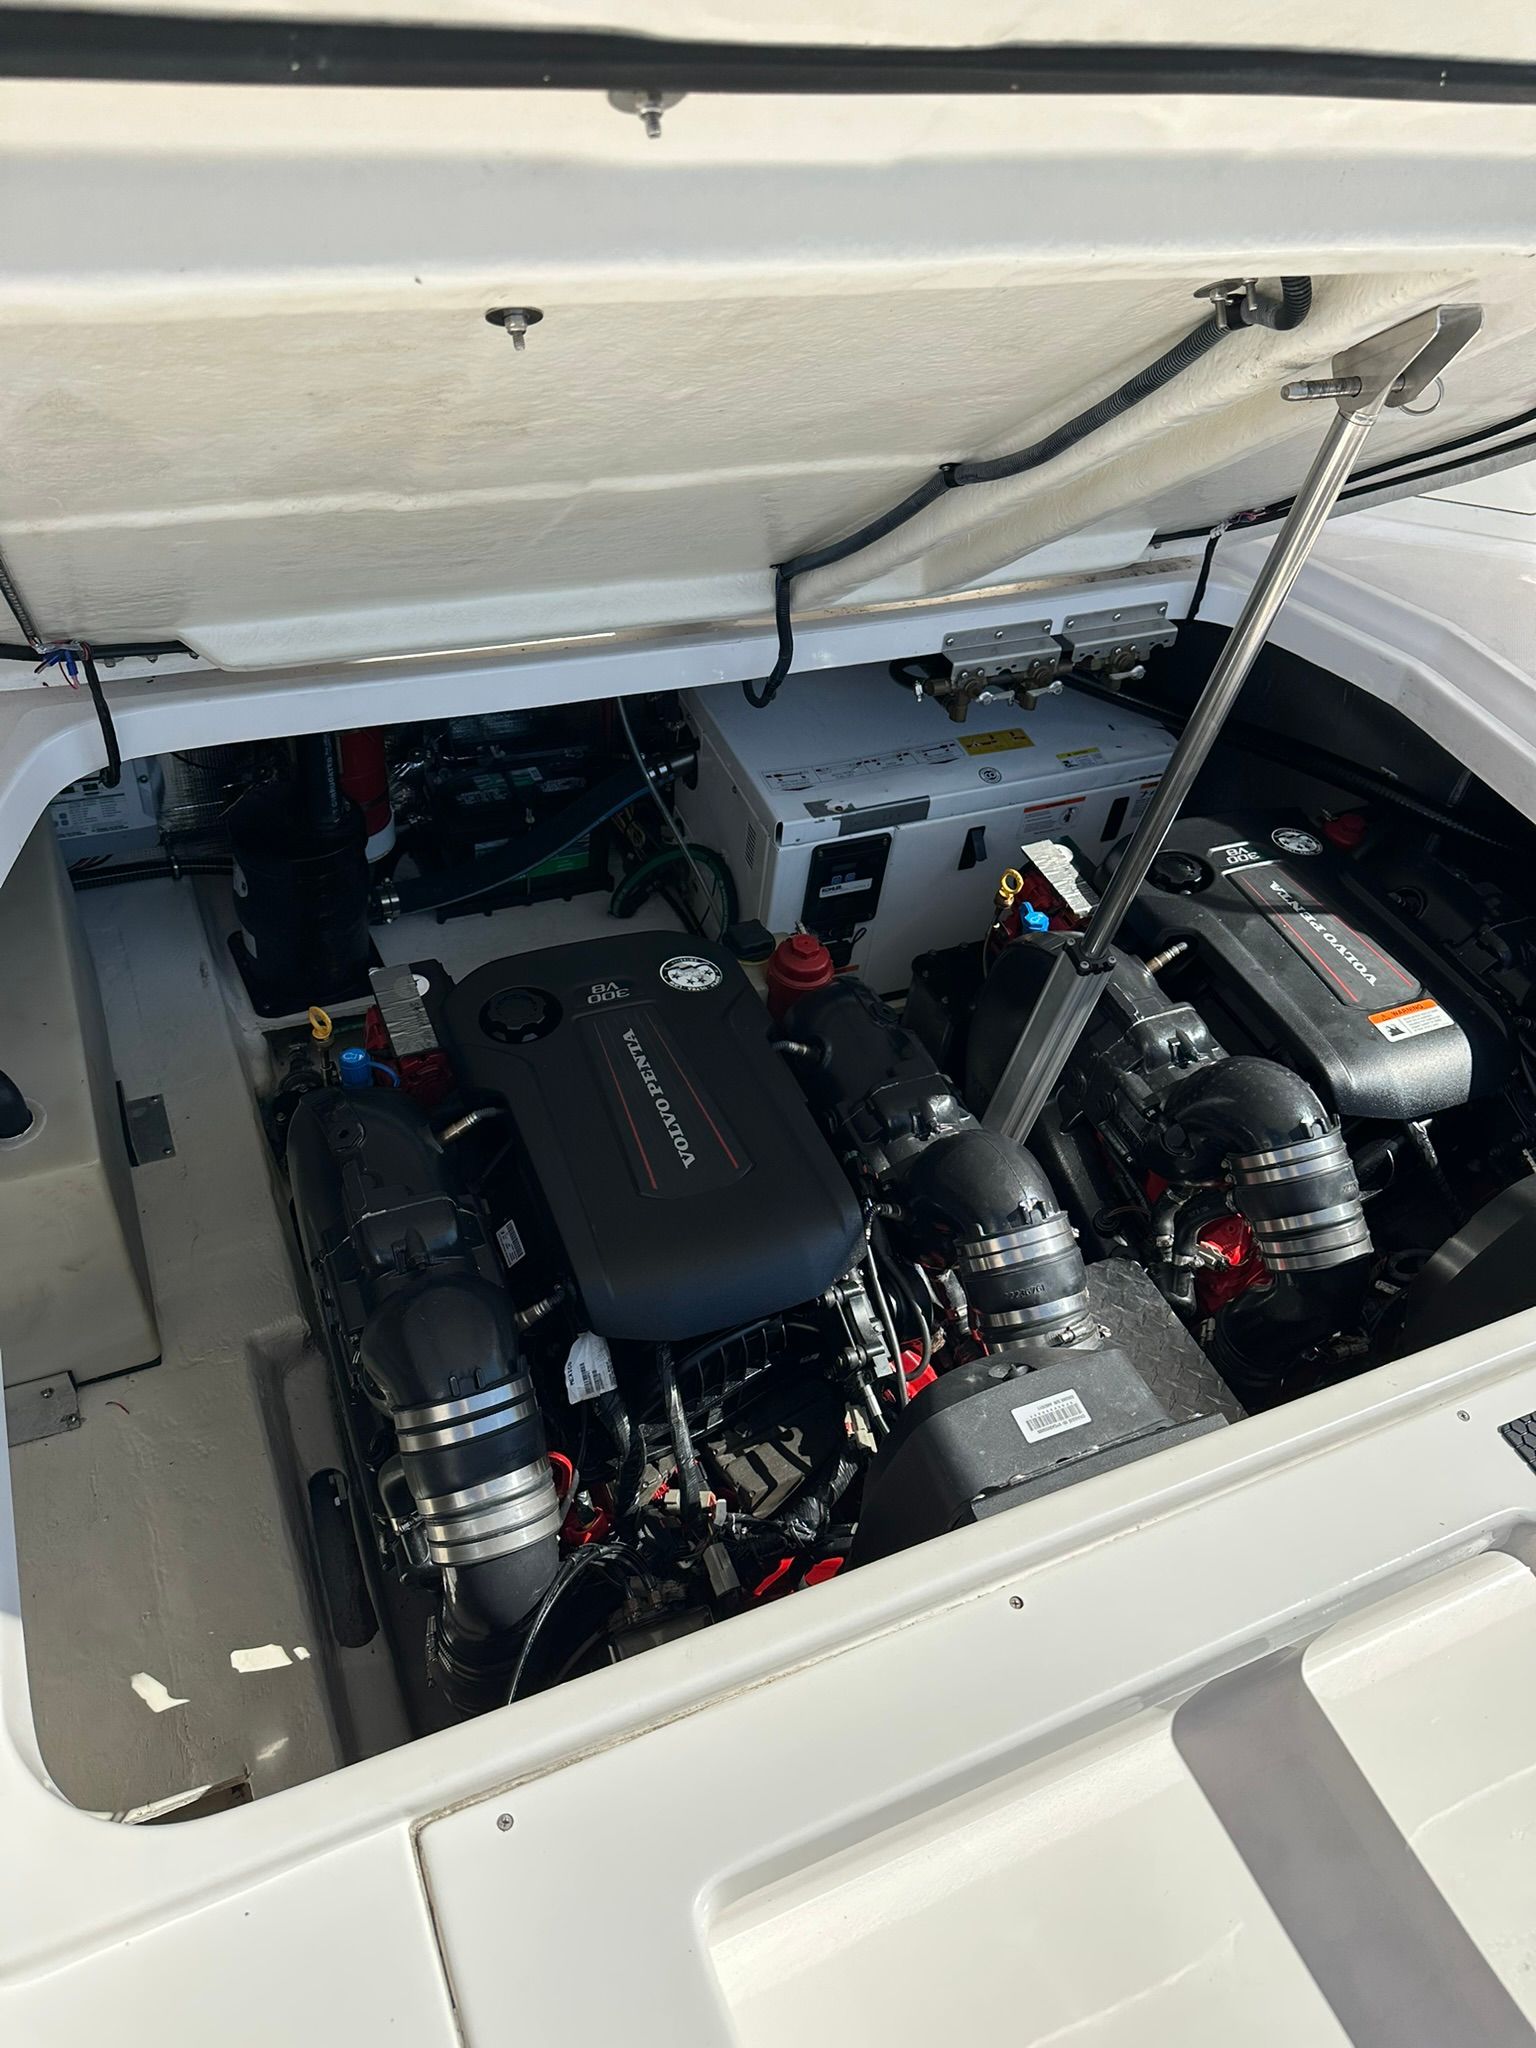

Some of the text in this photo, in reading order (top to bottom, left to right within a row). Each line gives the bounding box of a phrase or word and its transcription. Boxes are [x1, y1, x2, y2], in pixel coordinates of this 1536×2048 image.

[1226, 847, 1249, 857] V8
[1226, 851, 1260, 864] 300
[1269, 880, 1379, 987] VOLVO PENTA
[591, 981, 619, 994] V8
[587, 988, 630, 1005] 300
[1391, 1003, 1424, 1017] WARNING
[622, 1027, 696, 1169] VOLVO PENTA
